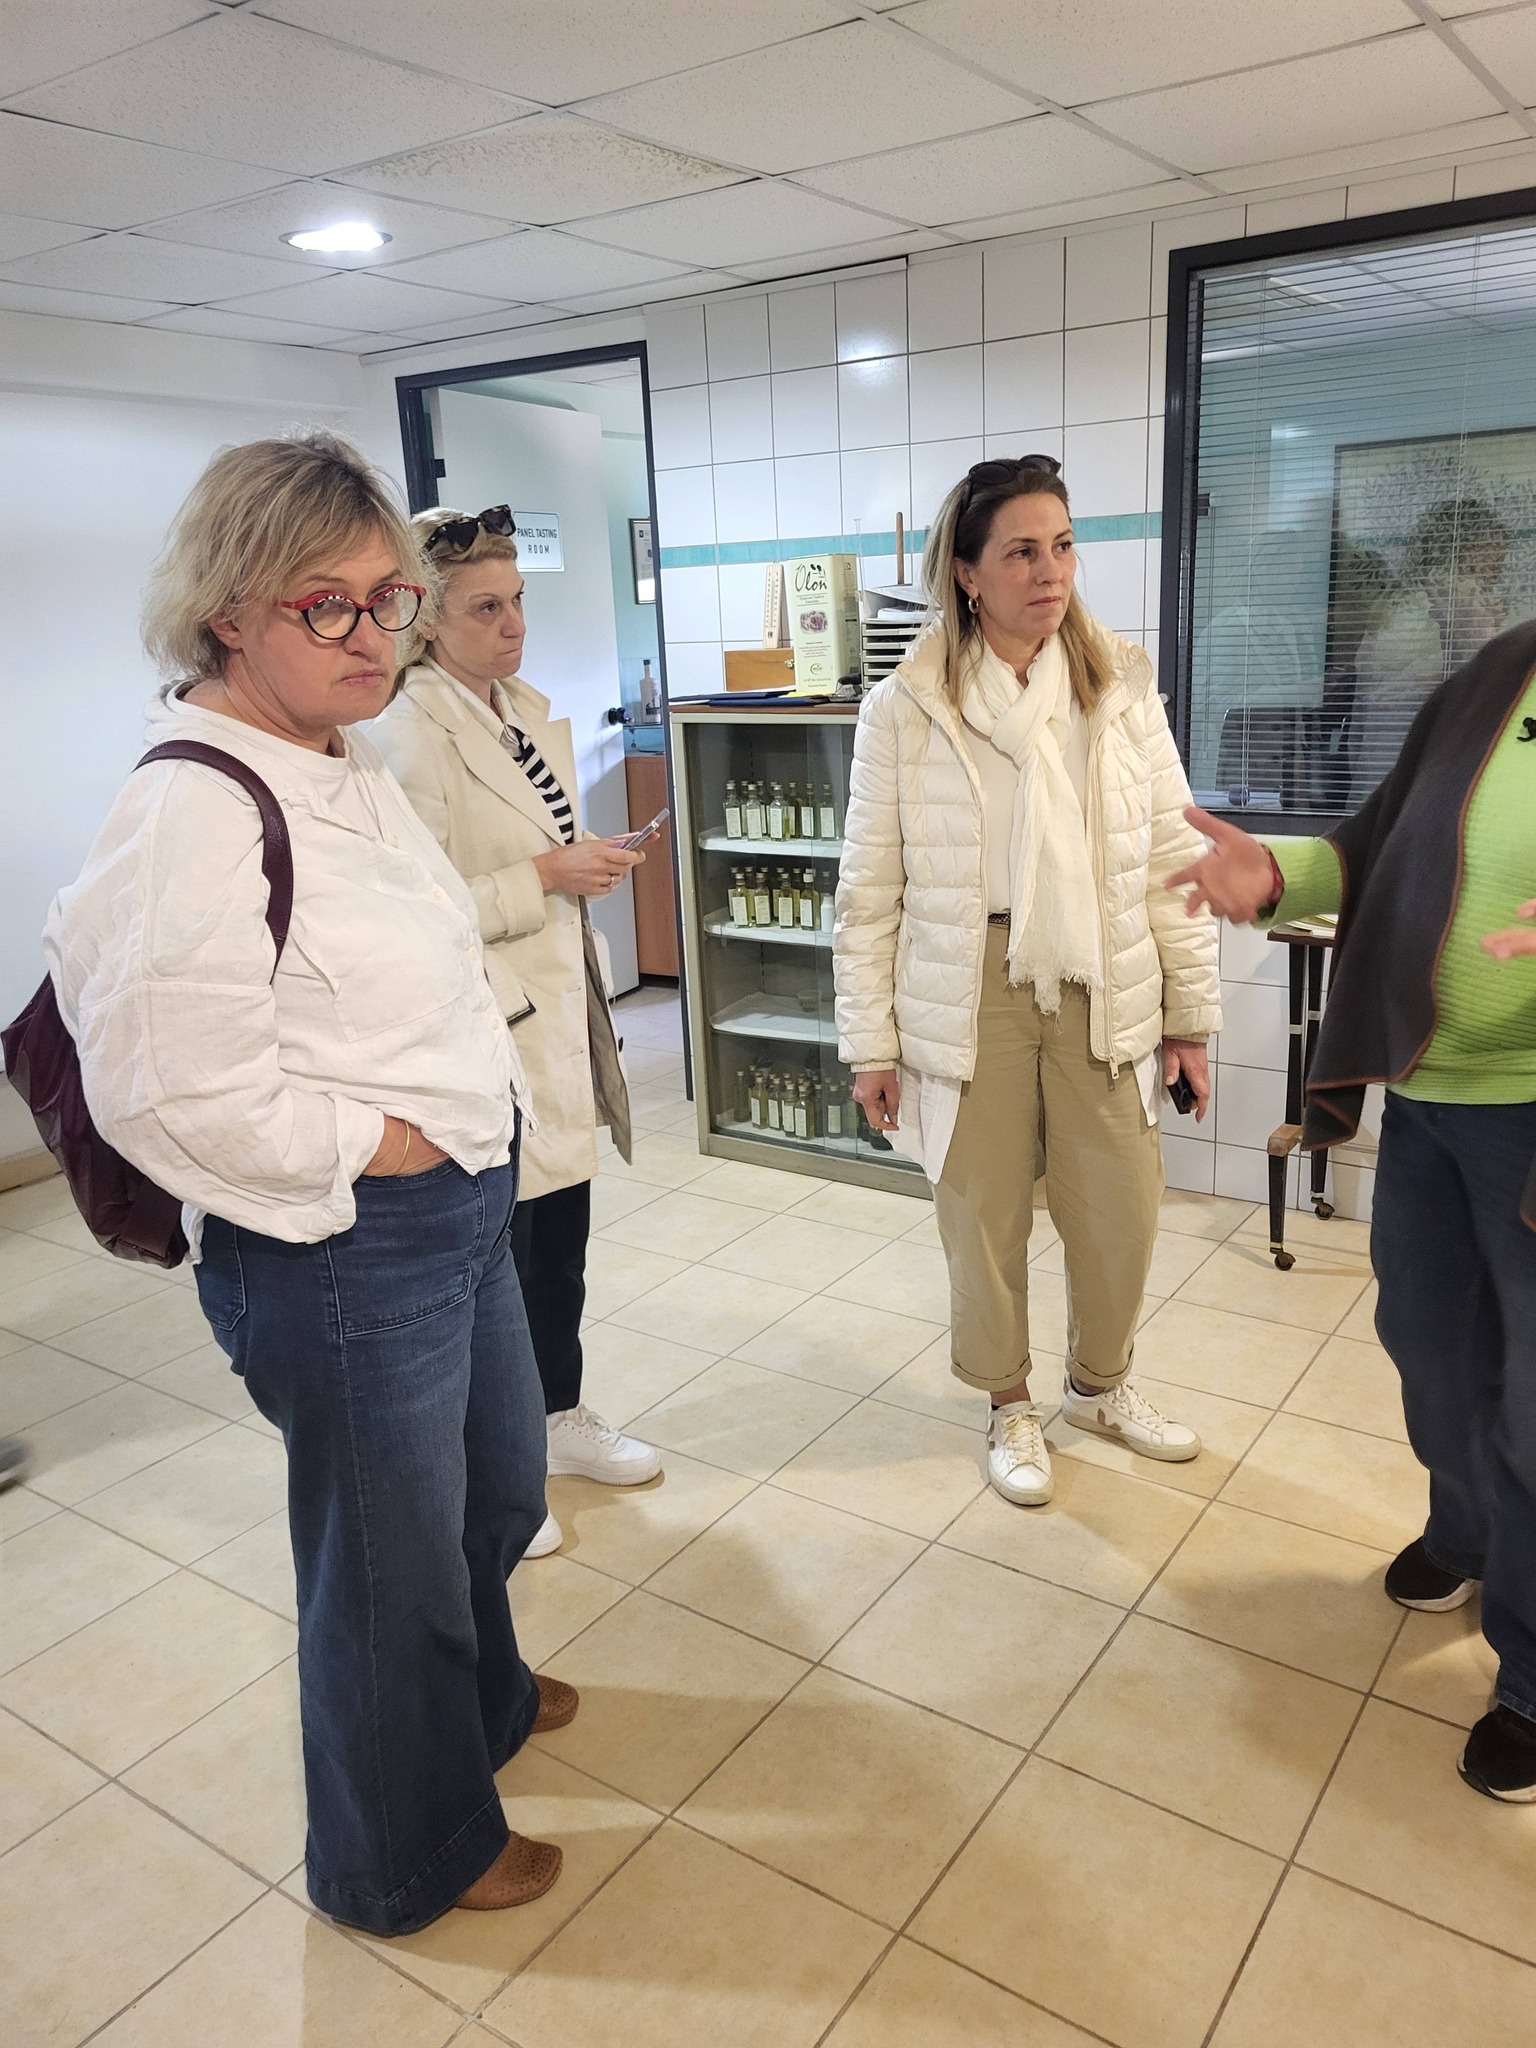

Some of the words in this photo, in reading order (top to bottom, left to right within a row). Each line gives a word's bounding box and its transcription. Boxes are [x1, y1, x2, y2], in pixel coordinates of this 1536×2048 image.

[517, 528, 536, 538] PANEL
[536, 528, 558, 538] TASTING
[528, 544, 550, 554] ROOM
